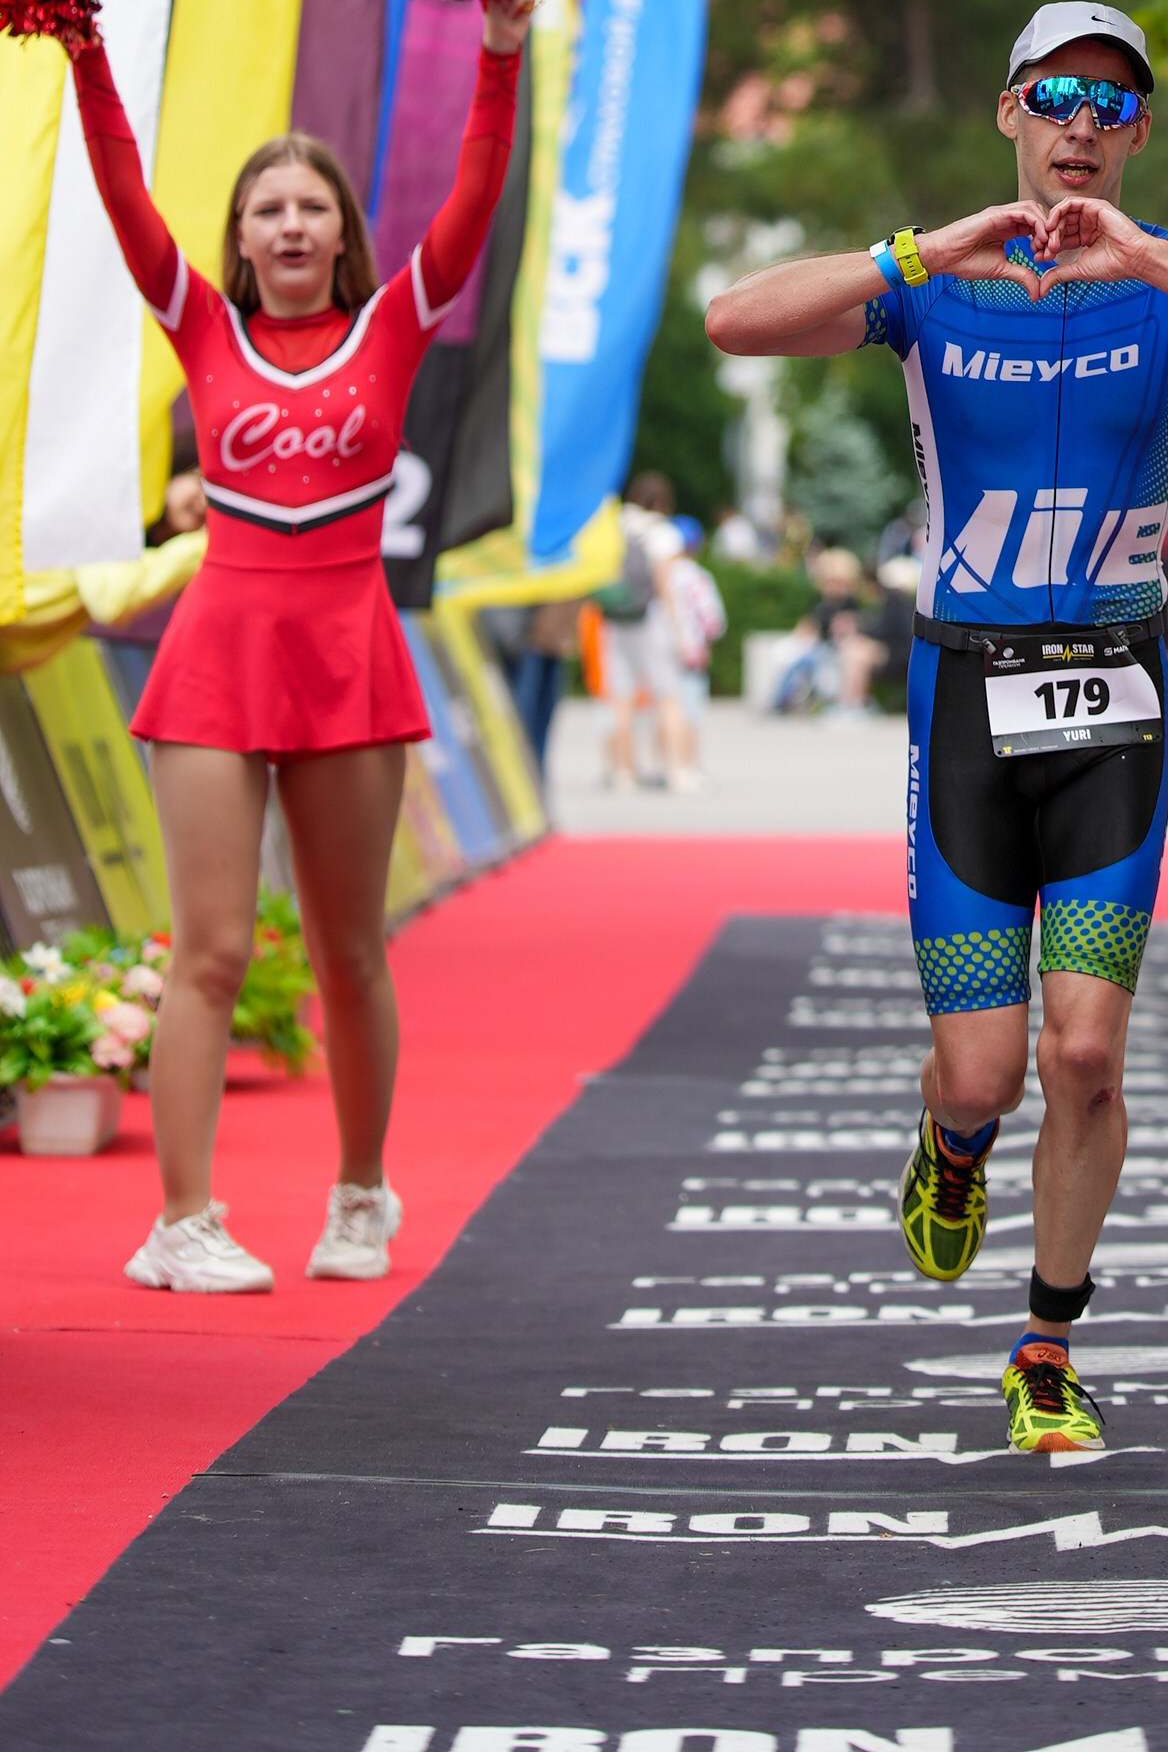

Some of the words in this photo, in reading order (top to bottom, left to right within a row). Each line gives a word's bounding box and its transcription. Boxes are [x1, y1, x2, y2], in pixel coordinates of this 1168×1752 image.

[941, 341, 1139, 382] Mieyco
[221, 401, 366, 472] Cool
[1042, 644, 1064, 655] IRON
[1072, 644, 1095, 654] STAR
[1034, 677, 1110, 720] 179
[1062, 728, 1091, 742] YURI
[537, 1426, 958, 1452] IRON
[487, 1503, 950, 1535] IRON
[363, 1724, 955, 1752] IRON
